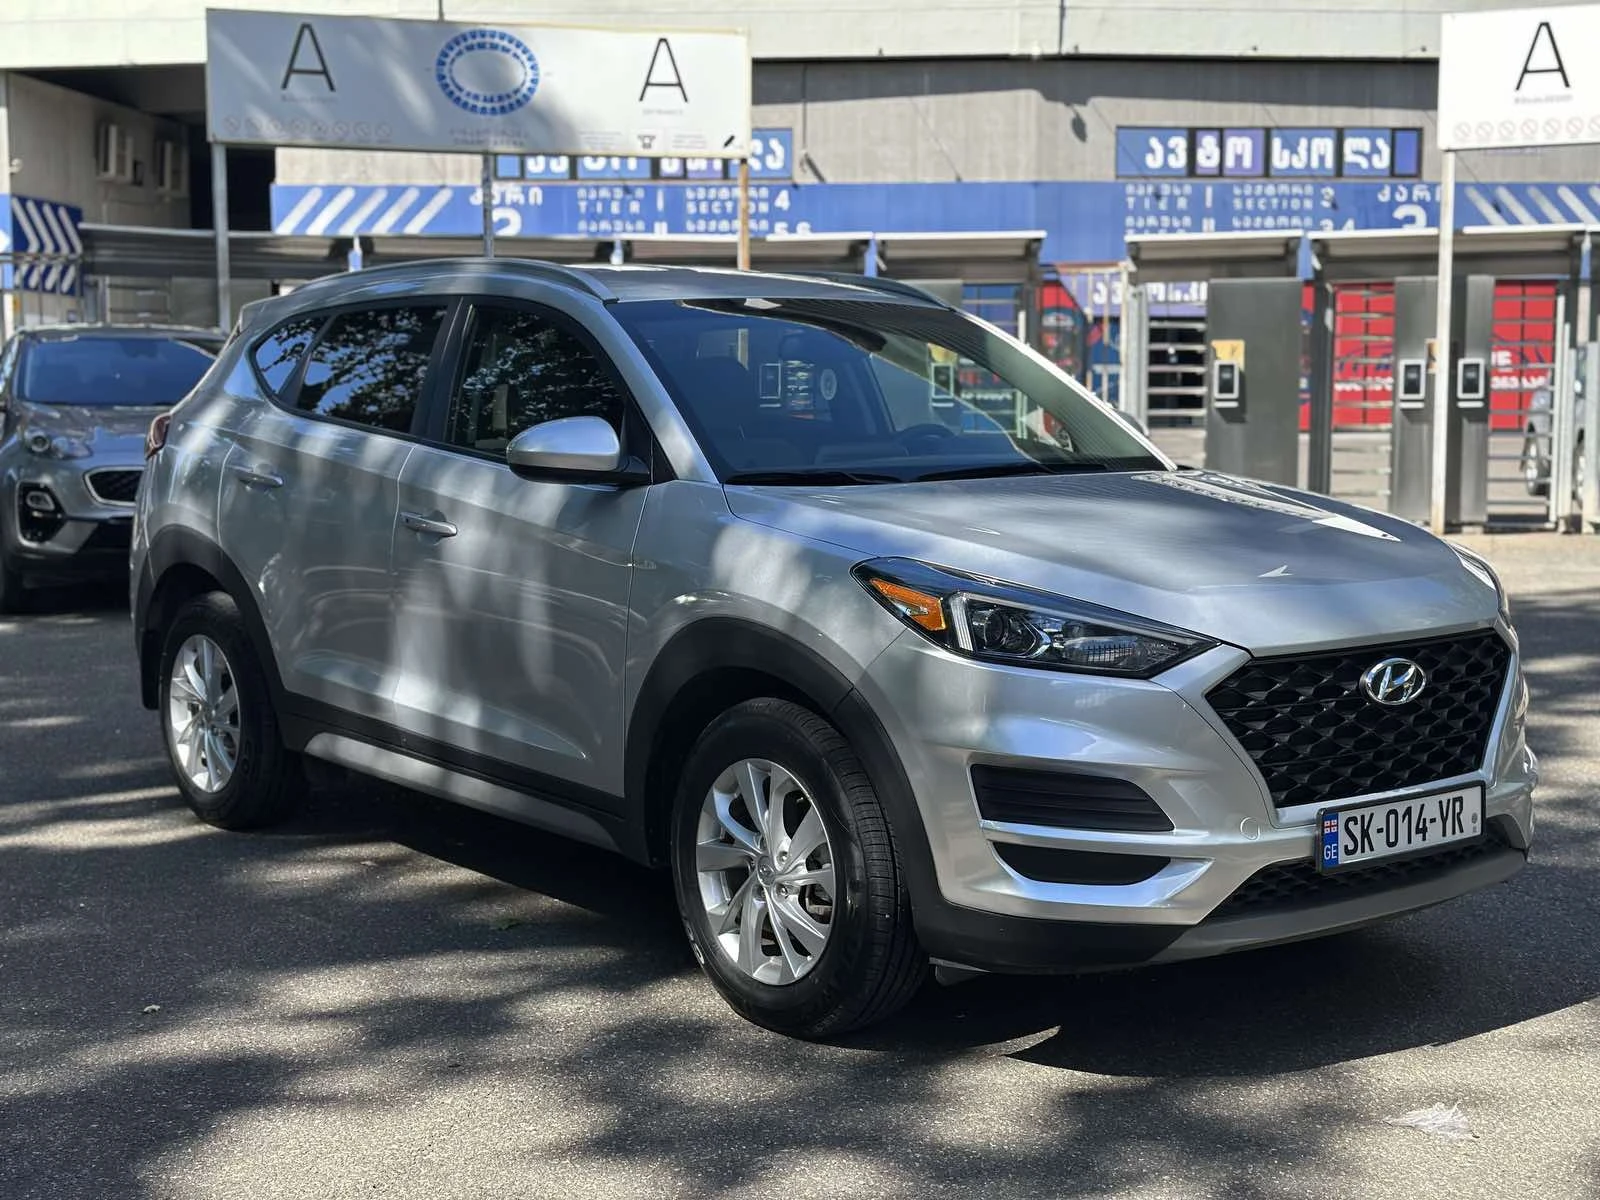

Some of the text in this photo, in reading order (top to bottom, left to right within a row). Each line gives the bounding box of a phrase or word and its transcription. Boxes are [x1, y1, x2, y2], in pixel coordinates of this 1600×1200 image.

[281, 22, 336, 92] A
[639, 38, 688, 102] A
[1515, 21, 1571, 91] A
[577, 200, 641, 214] TIER
[686, 189, 791, 214] SECTON 4
[1233, 197, 1313, 211] SECTION
[1343, 796, 1464, 857] SK-014-YR
[1323, 843, 1338, 860] GE
